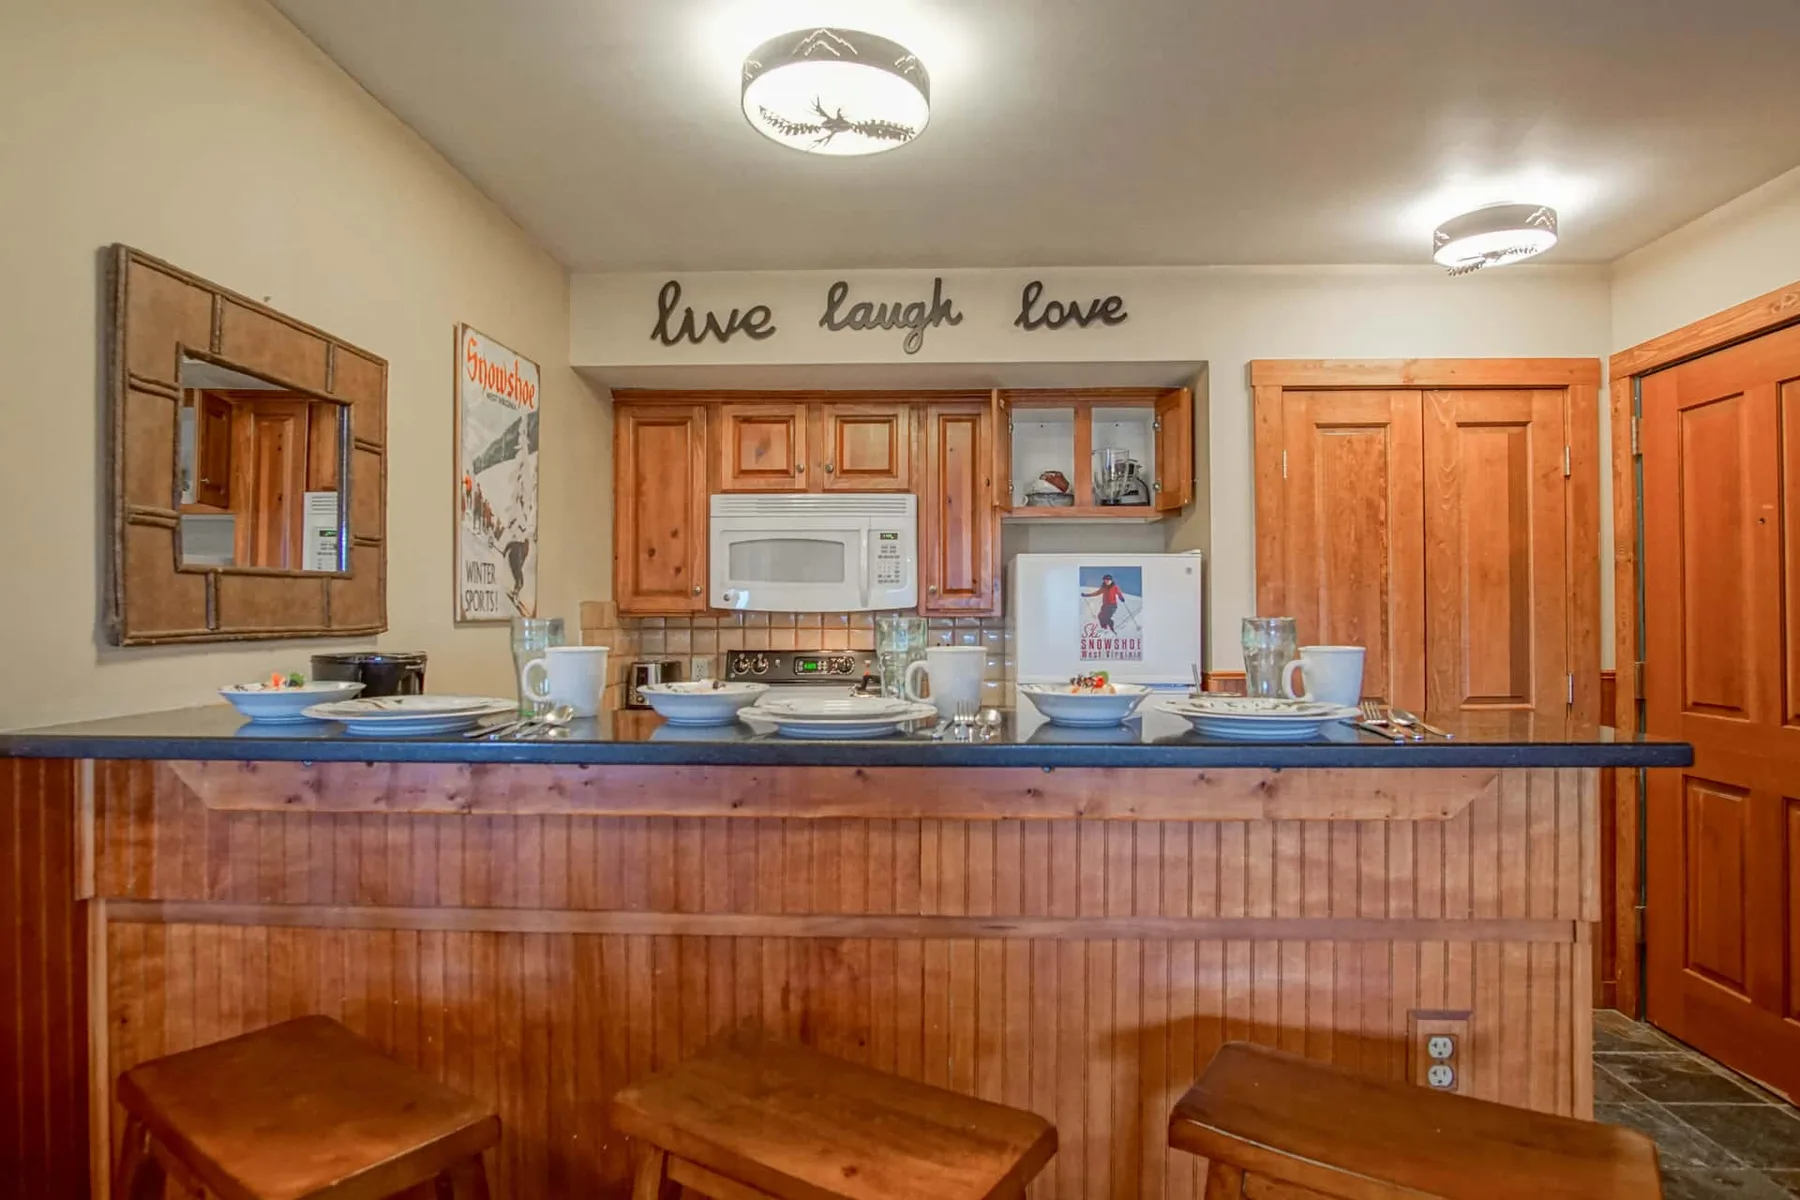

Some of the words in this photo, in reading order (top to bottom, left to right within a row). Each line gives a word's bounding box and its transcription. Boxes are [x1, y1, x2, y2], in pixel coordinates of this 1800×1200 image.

[650, 280, 776, 347] live
[819, 277, 963, 355] laugh
[1013, 280, 1128, 331] love
[467, 336, 535, 410] Snowshoe
[465, 560, 496, 584] WINTER
[464, 589, 498, 612] SPORTS!
[1081, 622, 1101, 638] Ski
[1080, 638, 1141, 650] SNOWSHOE
[1080, 650, 1102, 659] West
